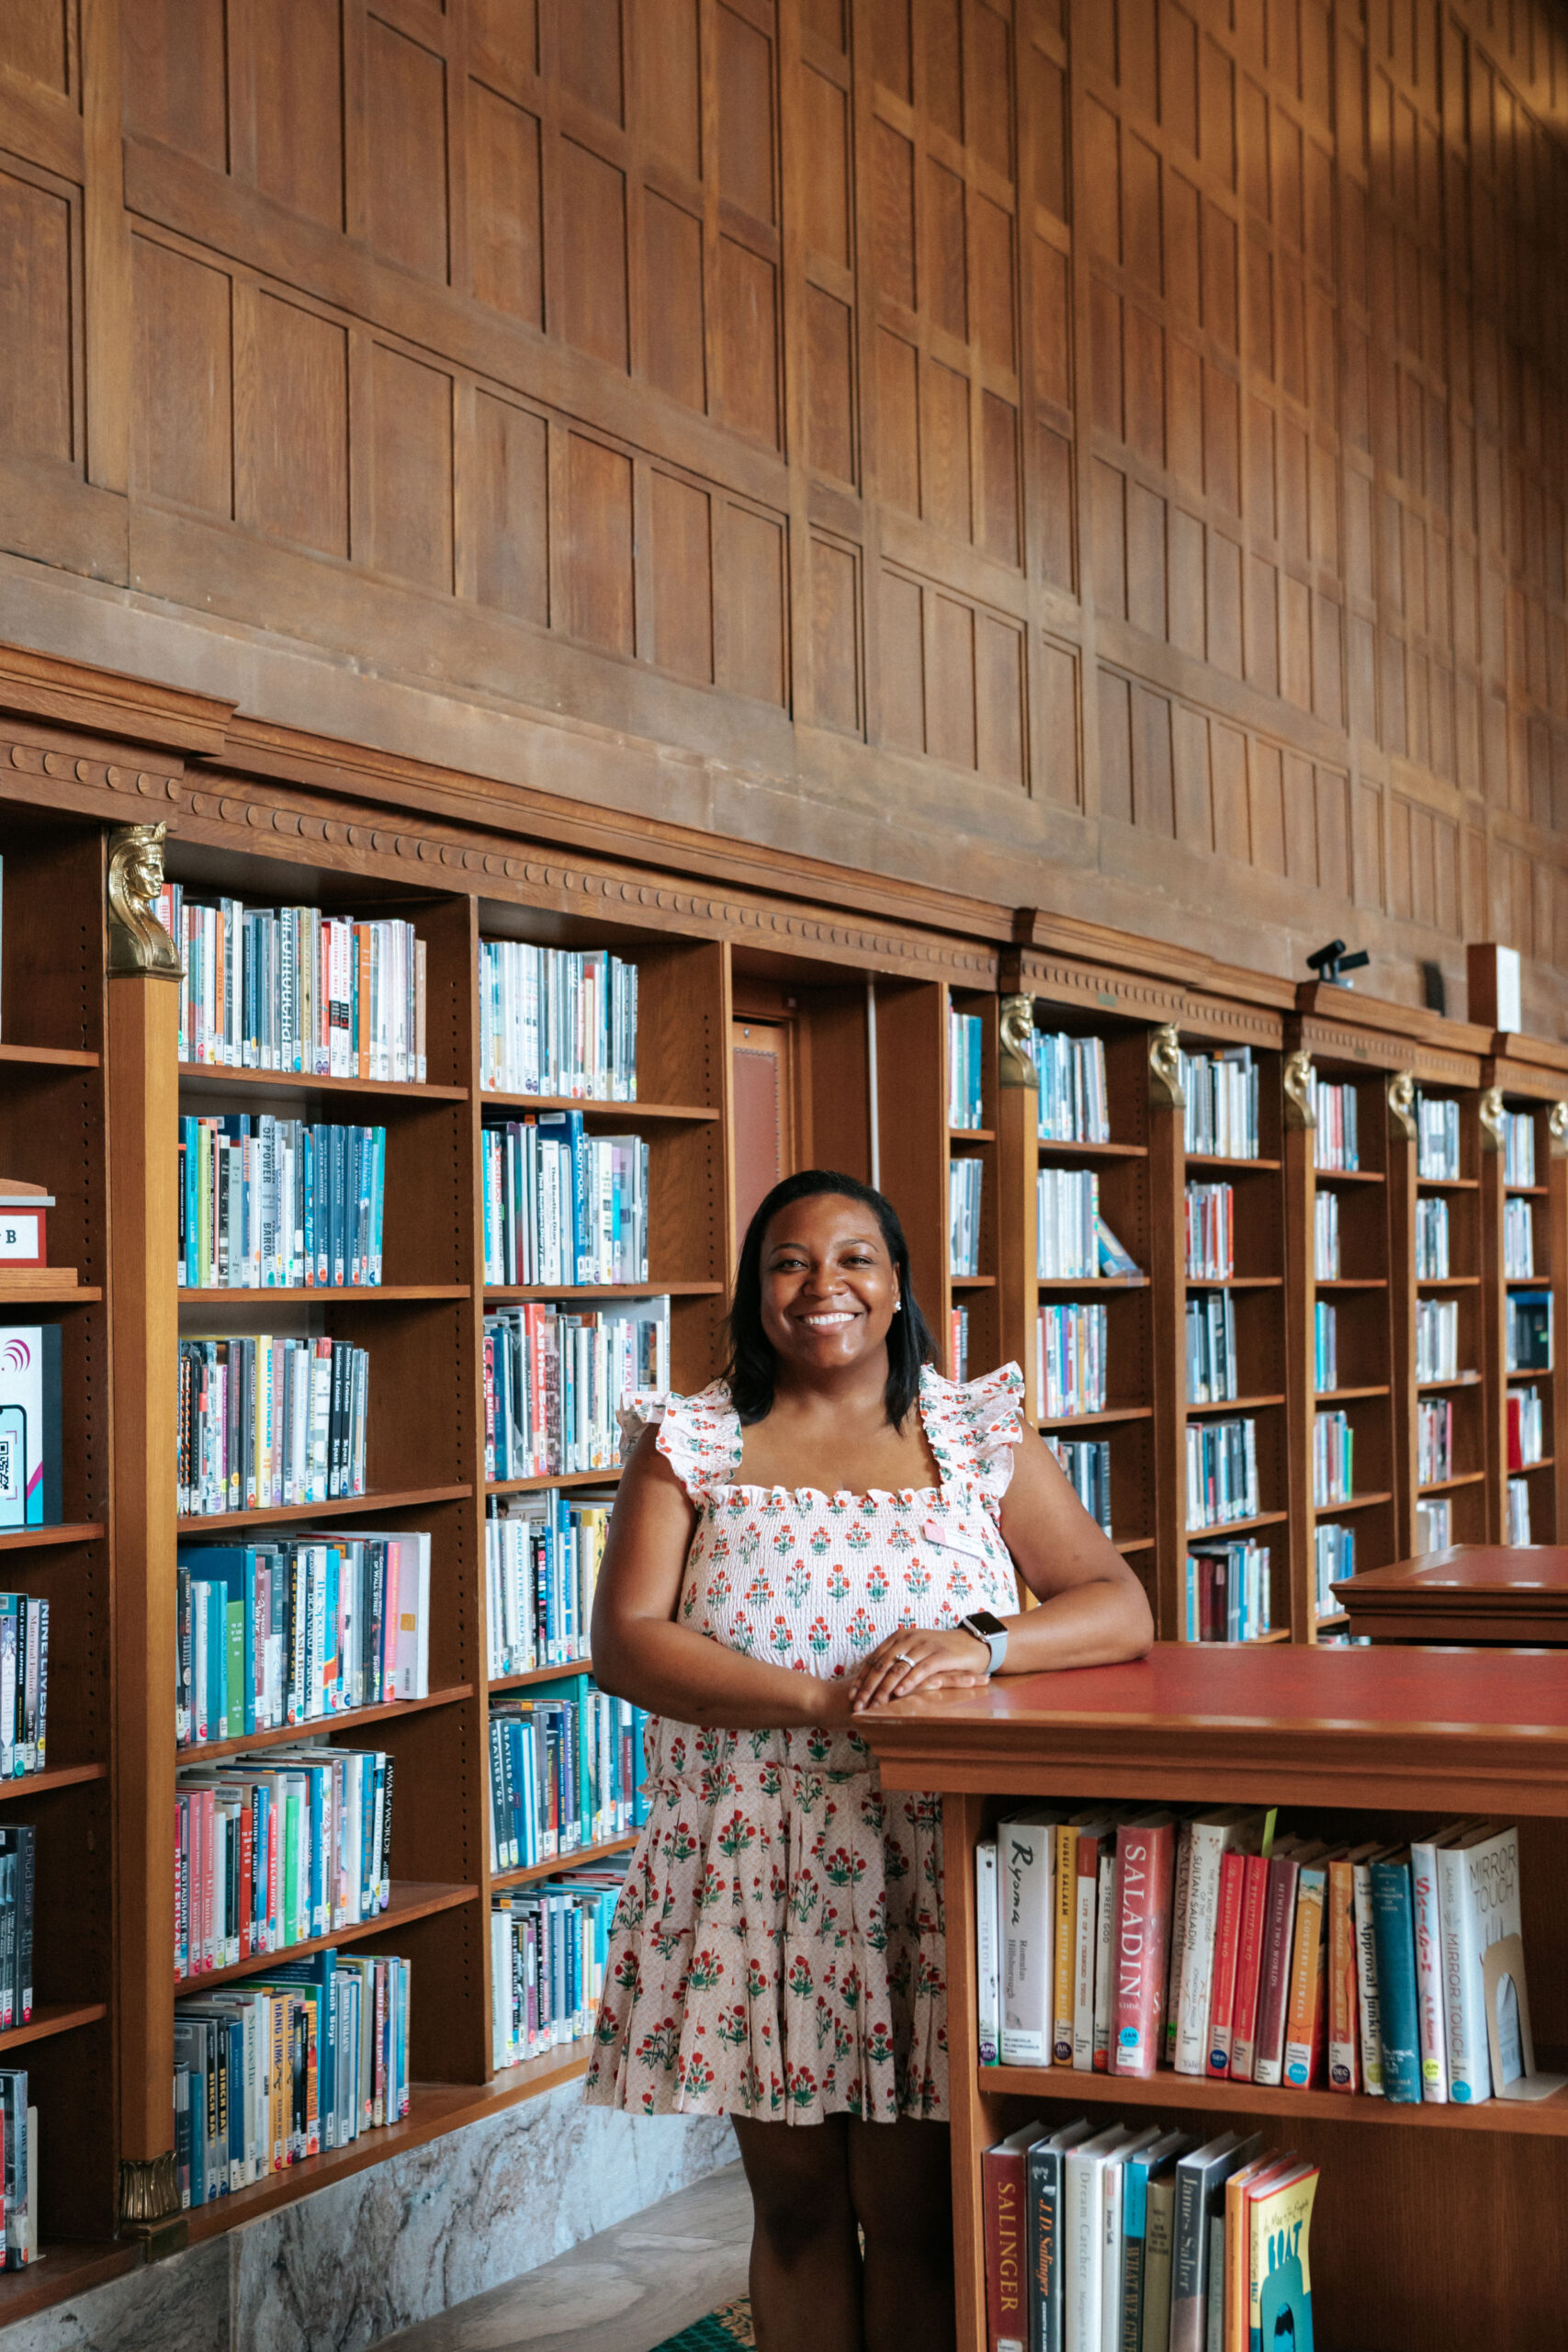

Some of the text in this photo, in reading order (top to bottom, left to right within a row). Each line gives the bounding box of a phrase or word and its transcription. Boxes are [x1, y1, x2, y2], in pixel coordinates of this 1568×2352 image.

[263, 1127, 271, 1183] OF POWER
[6, 1229, 17, 1243] B
[536, 1320, 545, 1350] All
[41, 1604, 50, 1655] NINE
[28, 1663, 37, 1697] Failure
[39, 1657, 48, 1716] LIVES
[492, 1729, 502, 1782] BEATLES
[504, 1726, 513, 1779] BEATLES
[1008, 1839, 1033, 1928] Ryoma
[1470, 1845, 1517, 1881] MIRROR
[1102, 1885, 1111, 1923] STREET
[1188, 1854, 1201, 1951] SULTAN SALADIN
[1200, 1892, 1205, 1903] OF
[1223, 1882, 1234, 1938] BEAUTIFUL
[1246, 1885, 1258, 1940] BEAUTIFUL
[1473, 1875, 1515, 1913] TOUCH
[1082, 1921, 1088, 1931] OF
[1119, 1844, 1146, 1999] SALADIN
[1270, 1883, 1285, 1988] BETWEEN TWO WORLDS
[1300, 1919, 1310, 1966] COUNTRY
[1007, 1939, 1016, 1999] Hillsborough
[1019, 1939, 1027, 1982] Romulus
[1222, 1942, 1229, 1957] NO
[1246, 1944, 1253, 1961] NO
[1446, 1932, 1461, 1996] MIRROR
[1297, 1971, 1307, 2019] BETWEEN
[1360, 1920, 1379, 2039] Approval Junkie
[1039, 2199, 1053, 2212] J.
[1079, 2172, 1090, 2218] Dream
[998, 2181, 1019, 2312] SALINGER
[1039, 2215, 1052, 2232] D.
[1179, 2176, 1198, 2291] James Salter
[1036, 2236, 1053, 2296] Salinger
[1079, 2223, 1090, 2278] Catcher
[1125, 2246, 1139, 2289] WHAT
[1123, 2293, 1138, 2316] WE
